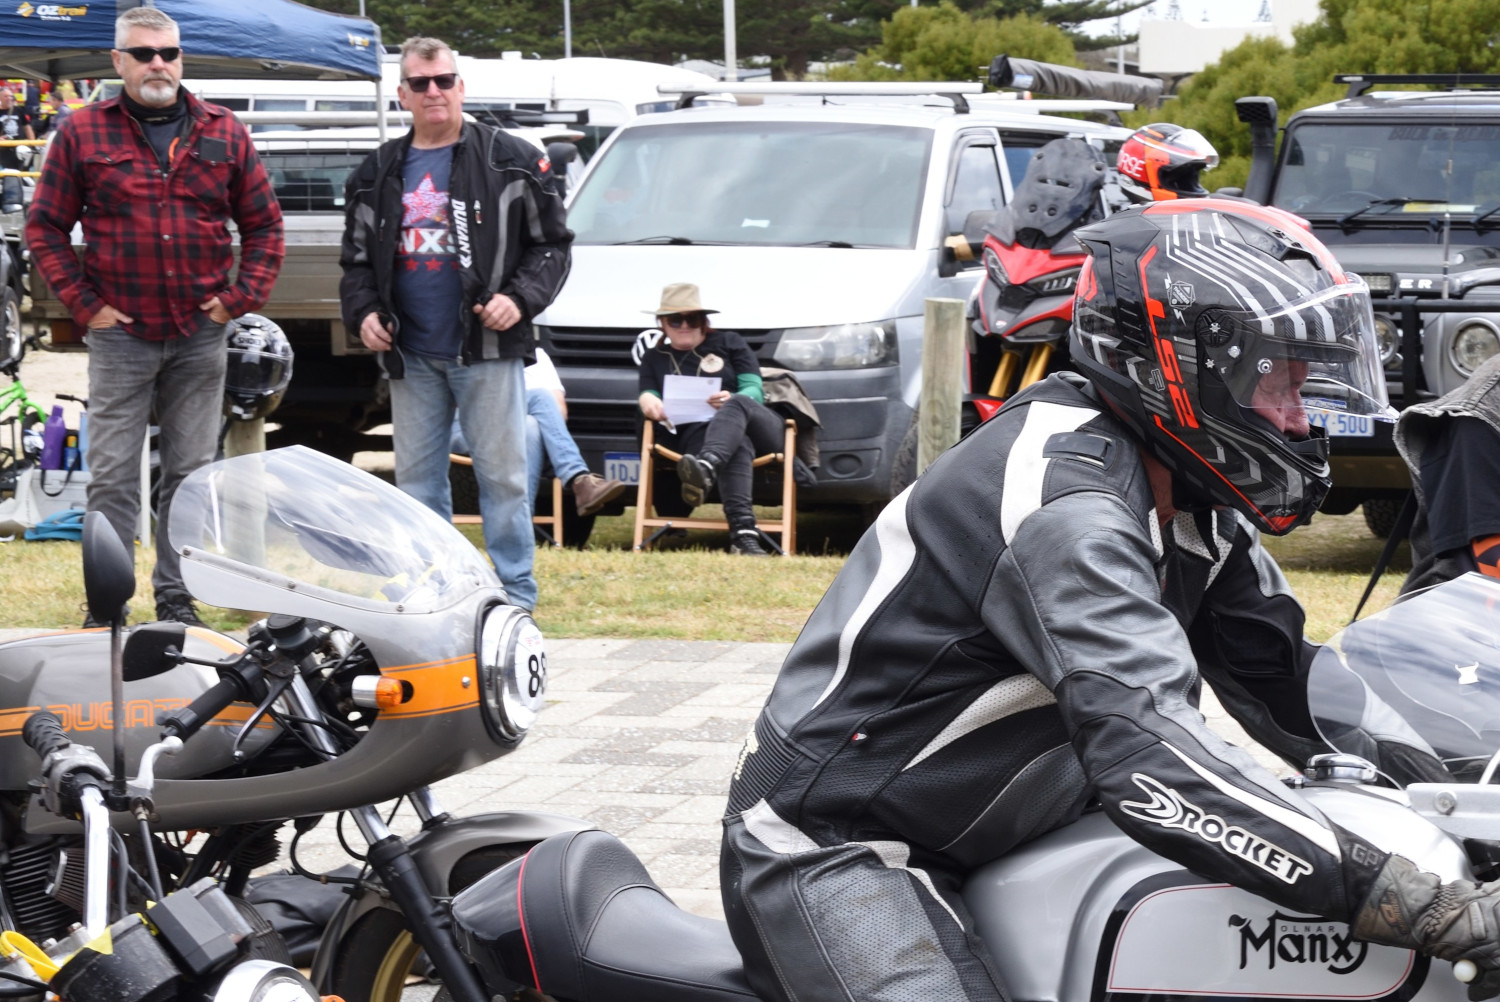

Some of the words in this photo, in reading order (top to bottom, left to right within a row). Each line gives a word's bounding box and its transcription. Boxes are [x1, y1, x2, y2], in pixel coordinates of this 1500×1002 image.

[1118, 149, 1146, 178] RSE
[452, 198, 472, 253] DUHAN
[1166, 788, 1314, 885] ROCKET
[1229, 910, 1368, 974] Manx
